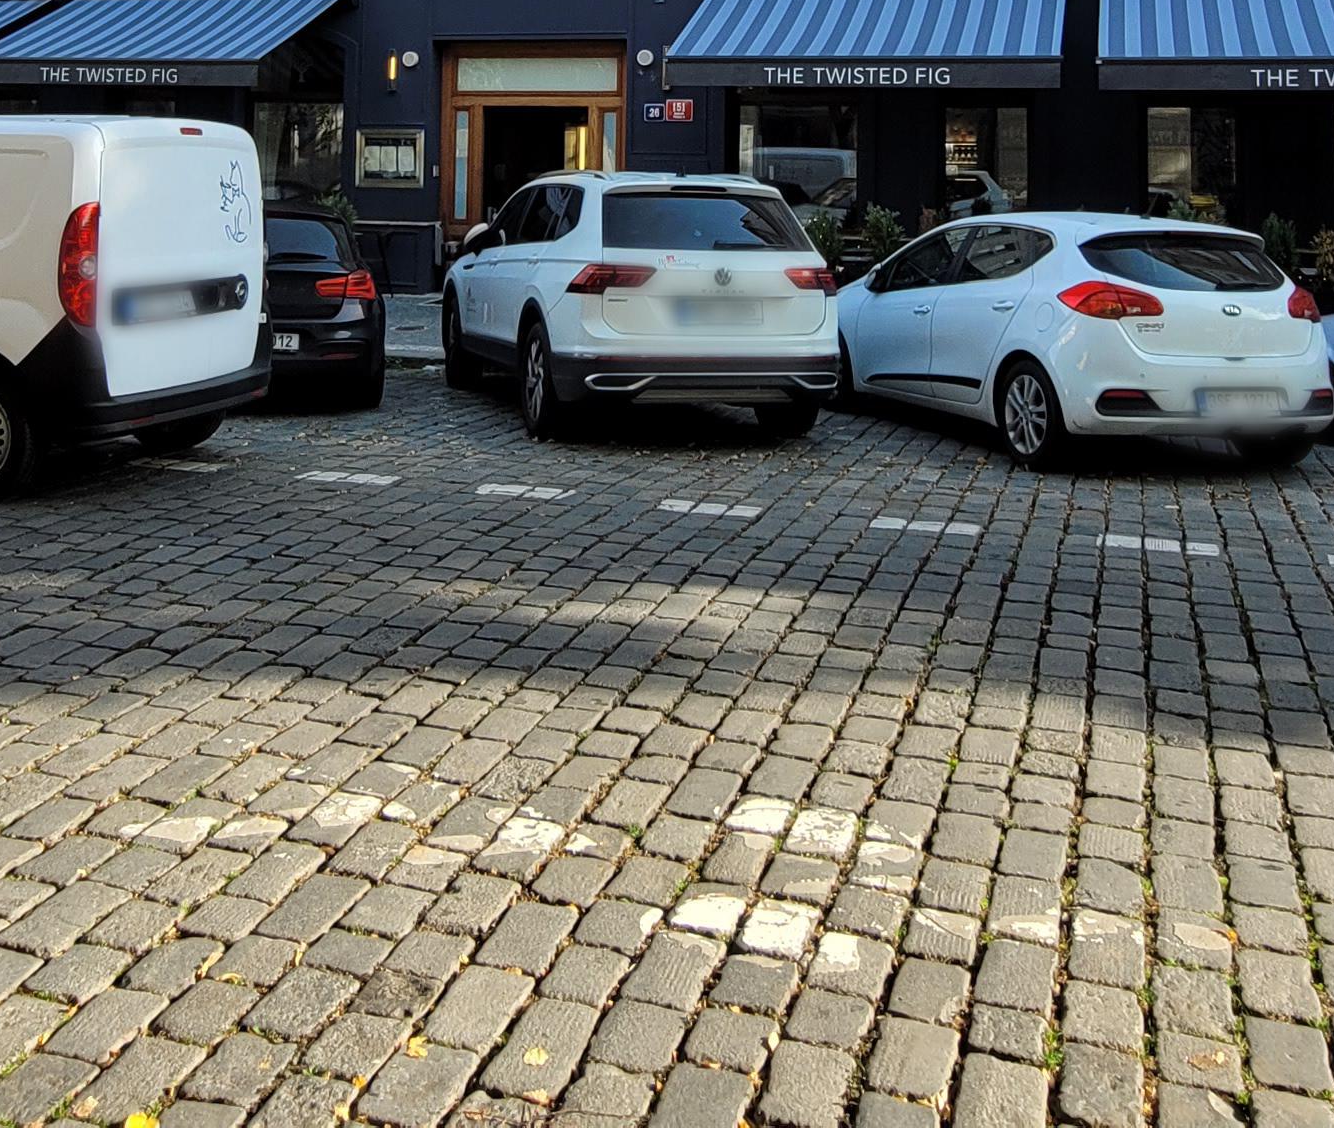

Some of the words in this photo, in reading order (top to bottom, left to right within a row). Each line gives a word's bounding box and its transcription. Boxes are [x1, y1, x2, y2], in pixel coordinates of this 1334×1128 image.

[40, 67, 70, 82] THE
[76, 67, 147, 83] TWISTED
[152, 68, 178, 84] FIG
[764, 67, 804, 84] THE
[813, 67, 908, 85] TWISTED
[915, 67, 951, 85] FIG
[1251, 68, 1299, 87] THE
[273, 335, 293, 348] 12
